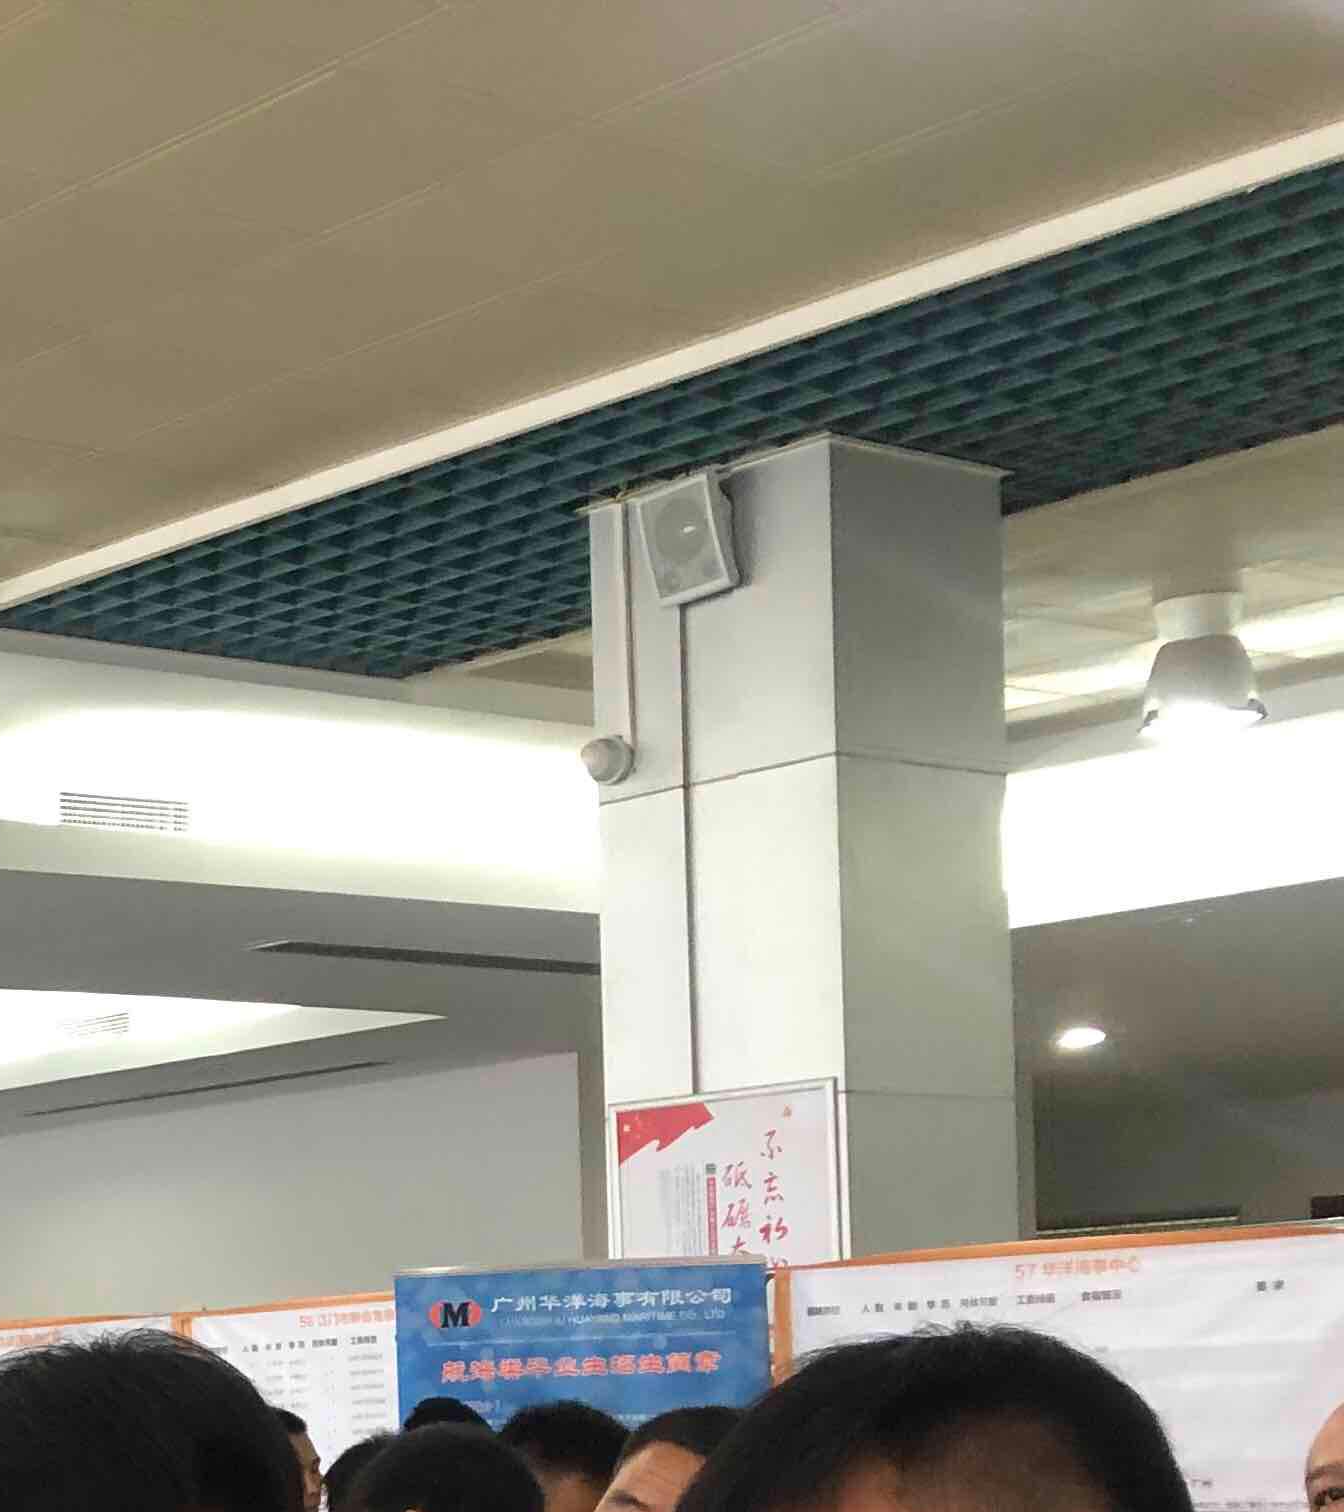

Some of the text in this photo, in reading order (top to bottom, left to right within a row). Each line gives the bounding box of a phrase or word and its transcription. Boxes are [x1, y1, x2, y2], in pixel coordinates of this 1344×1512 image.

[491, 1287, 732, 1313] 广州华洋海事有限公司
